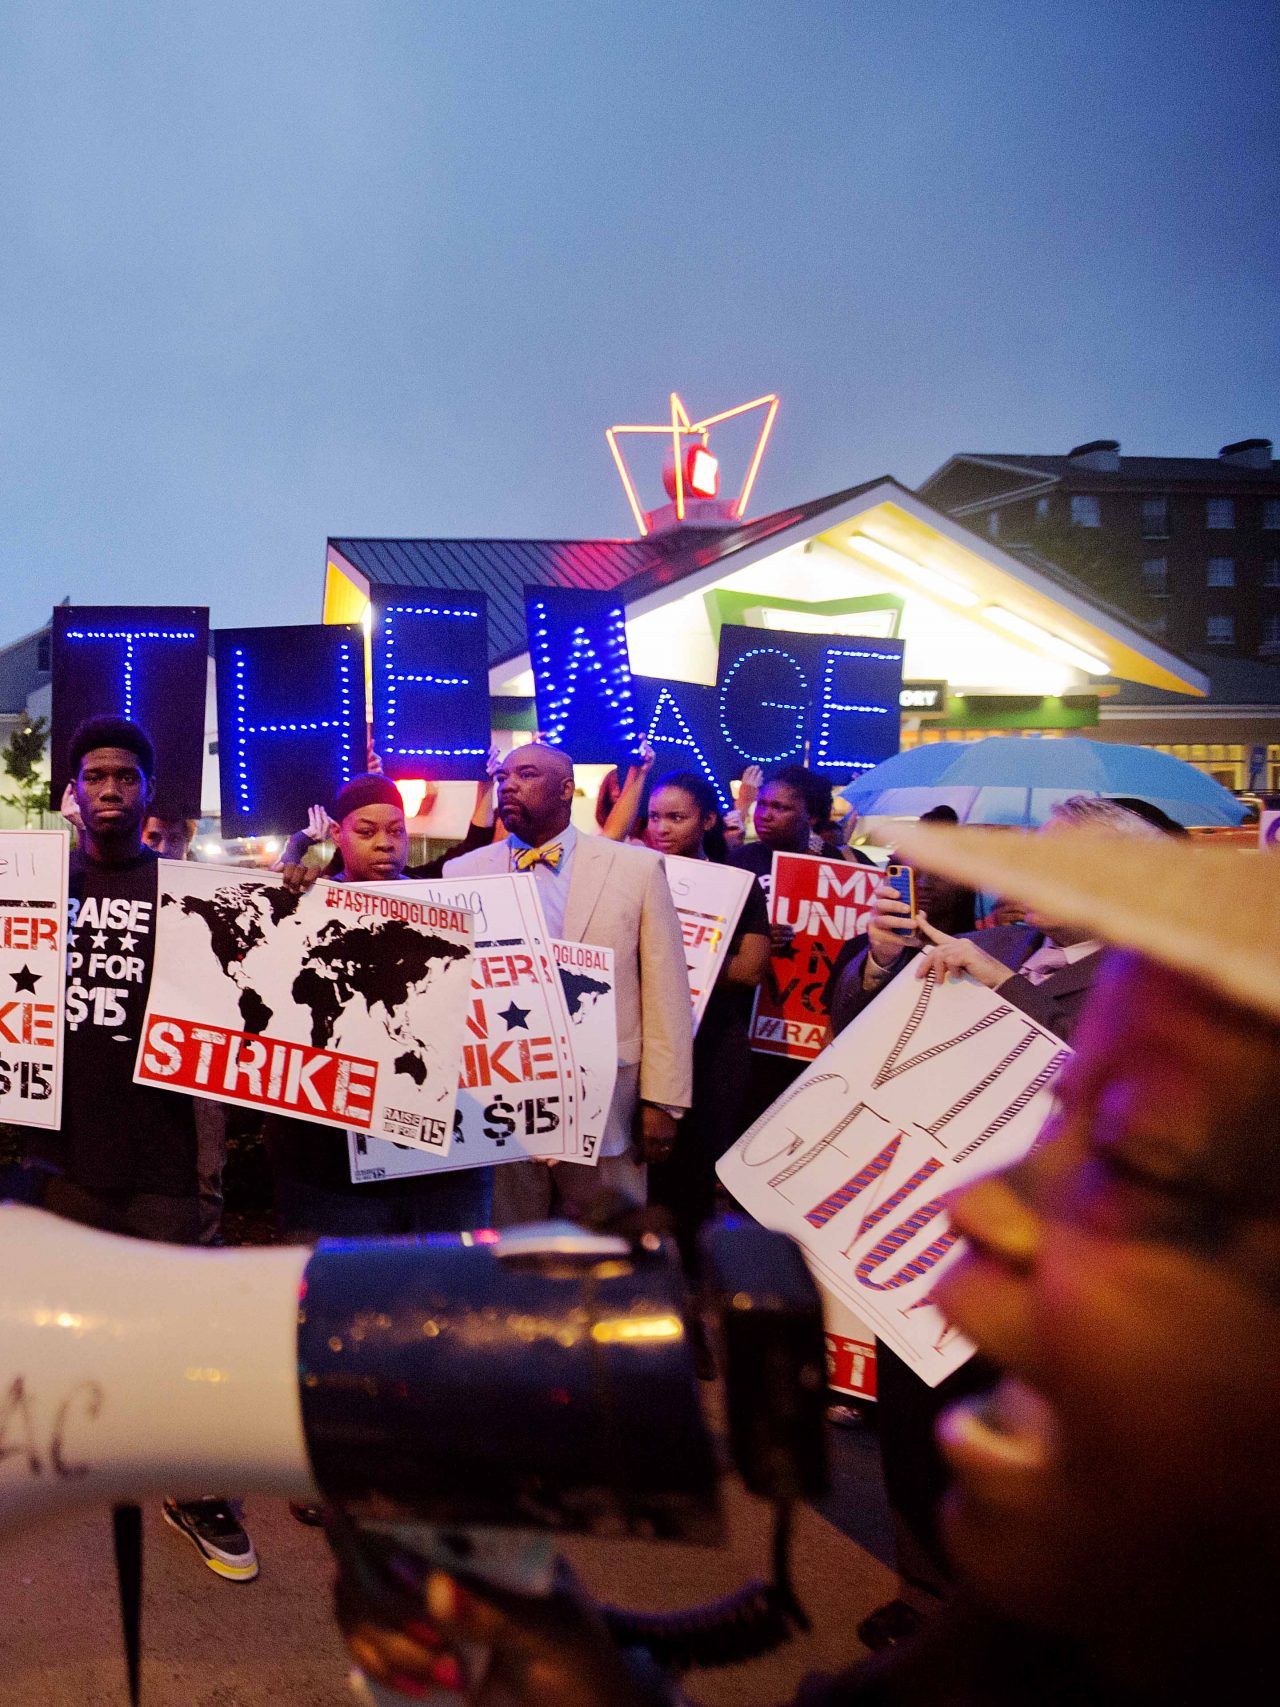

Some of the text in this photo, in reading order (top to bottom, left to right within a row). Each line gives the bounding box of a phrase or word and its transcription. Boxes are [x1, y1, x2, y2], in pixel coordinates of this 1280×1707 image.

[326, 886, 470, 934] #FASTFOODGLOBAL
[88, 954, 146, 984] FOR
[65, 977, 129, 1031] $15
[142, 1021, 376, 1122] STRIKE
[458, 1036, 558, 1090] IKE
[384, 1107, 421, 1127] RAISE
[422, 1117, 447, 1146] 15
[483, 1094, 560, 1146] $15
